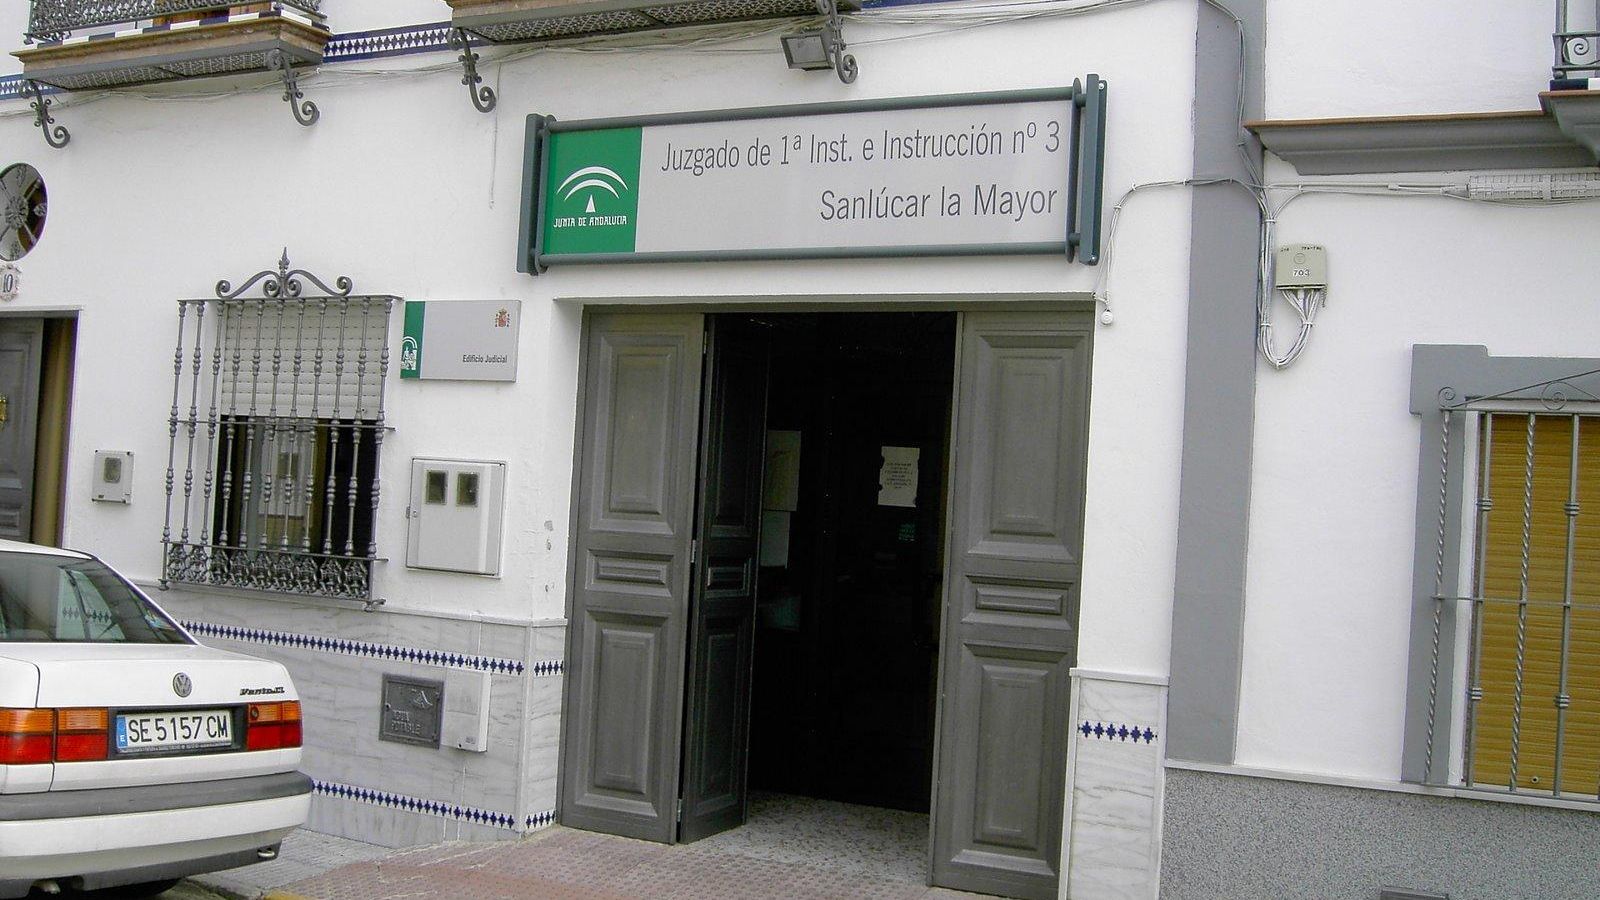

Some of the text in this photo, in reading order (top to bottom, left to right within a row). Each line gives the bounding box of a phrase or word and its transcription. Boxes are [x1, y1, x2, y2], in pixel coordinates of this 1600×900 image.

[661, 120, 1060, 176] Juzgado de 1ª Inst. e Instrucción nº 3
[820, 183, 1057, 222] Sanlúcar la Mayor
[553, 215, 627, 228] JUNTA DE ANDALUCIA
[1293, 268, 1310, 277] 703
[3, 273, 14, 293] 10
[462, 354, 508, 364] Edificio Judicial
[128, 718, 151, 743] SE
[154, 716, 203, 741] 5157
[206, 715, 228, 739] CM
